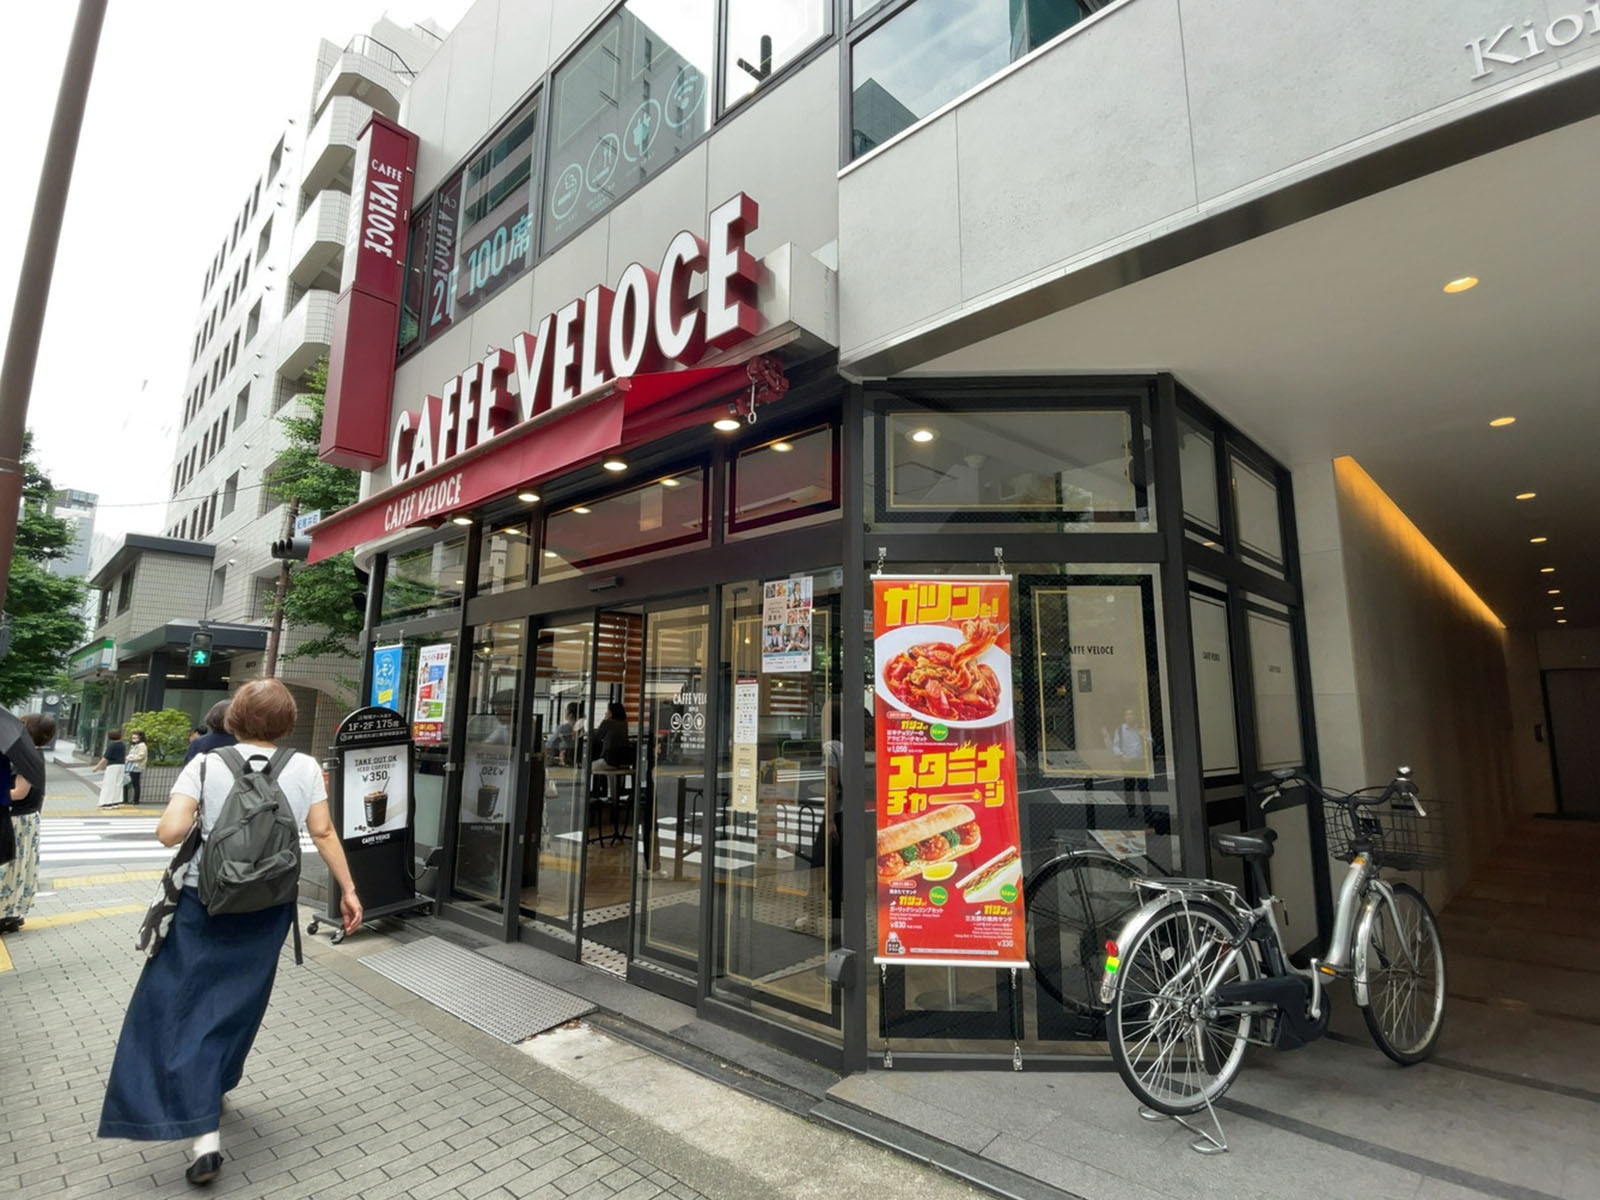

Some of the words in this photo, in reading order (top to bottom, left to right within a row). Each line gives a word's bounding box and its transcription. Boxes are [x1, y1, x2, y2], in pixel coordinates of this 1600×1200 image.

[364, 180, 400, 258] VELOCE
[431, 265, 460, 326] 2F
[467, 212, 534, 297] 100席
[513, 191, 756, 422] VELOCE
[417, 472, 463, 517] VELOCE
[1087, 645, 1115, 656] VELOCE
[354, 757, 371, 767] TAKE
[373, 756, 387, 765] OUT
[388, 755, 398, 763] OK
[362, 770, 388, 783] ¥350
[371, 763, 390, 771] COFFEE
[888, 740, 1005, 791] スタミナ
